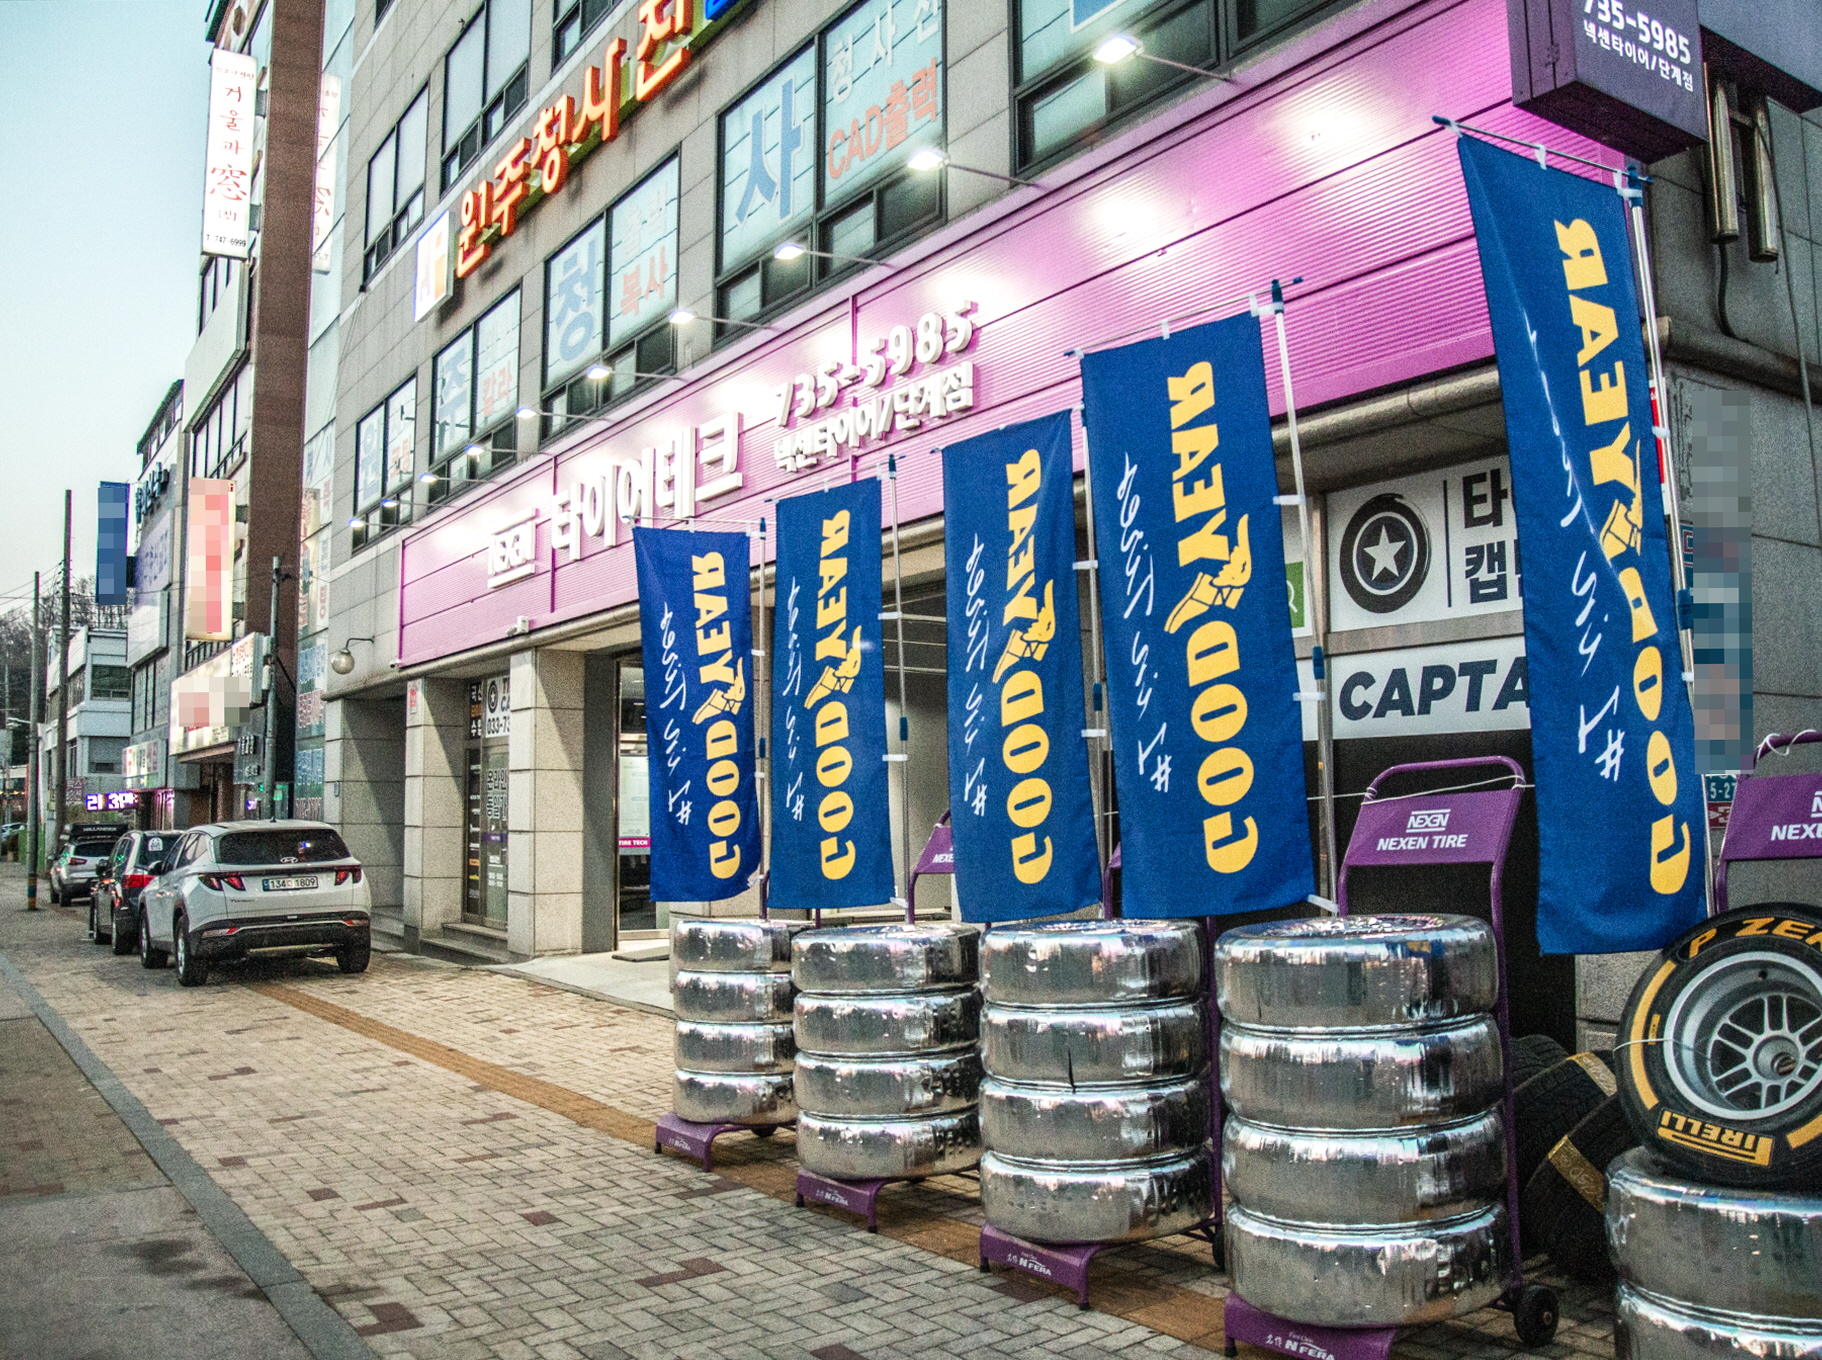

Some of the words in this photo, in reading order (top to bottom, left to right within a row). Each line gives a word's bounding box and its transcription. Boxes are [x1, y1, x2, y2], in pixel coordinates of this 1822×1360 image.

[1583, 19, 1694, 92] 넥센타이어/단계점
[456, 0, 692, 278] 원주청사진
[828, 57, 937, 179] CAD출력
[555, 237, 598, 362] 청
[735, 75, 803, 227] 사
[620, 247, 668, 316] 복사
[775, 300, 973, 428] 735-5985
[773, 361, 975, 473] 넥센타이어/단계점
[551, 411, 743, 561] 타이어테크
[1464, 540, 1523, 604] 캡
[1376, 836, 1429, 851] NEXEN
[1432, 833, 1468, 848] TIRE
[294, 878, 316, 888] 1809
[1689, 928, 1717, 958] P
[1658, 1110, 1774, 1166] PIRELLI
